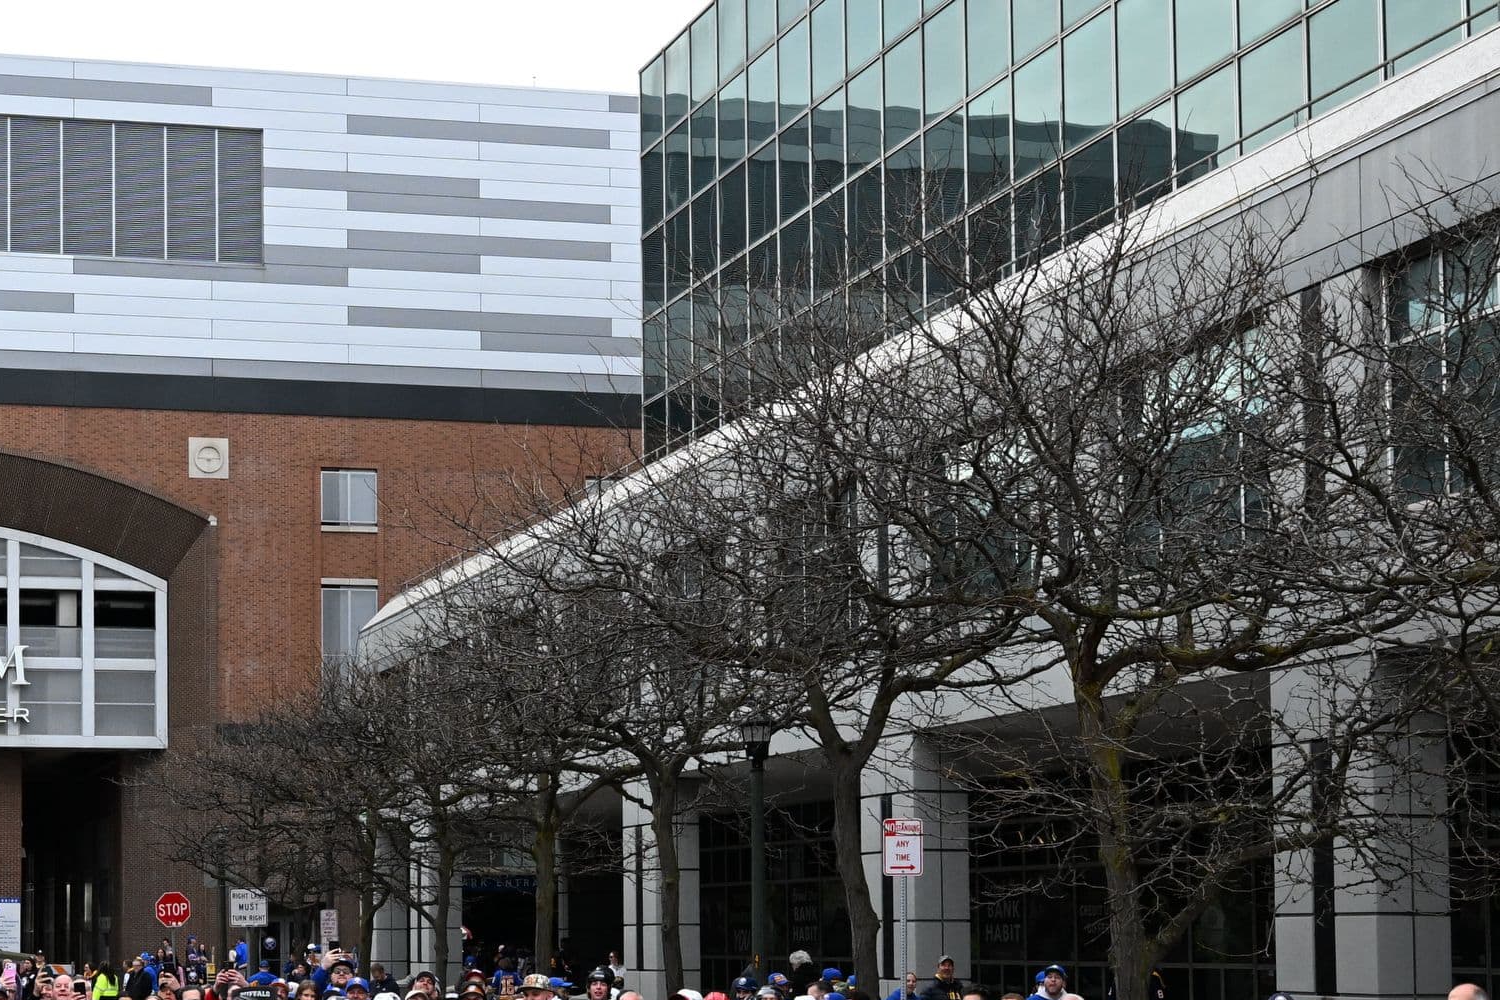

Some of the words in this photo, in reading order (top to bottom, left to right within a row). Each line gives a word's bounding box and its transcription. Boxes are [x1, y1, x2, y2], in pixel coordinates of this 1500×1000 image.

[885, 820, 895, 835] NO
[896, 840, 909, 848] ANY
[896, 853, 910, 861] TIME
[158, 903, 188, 917] STOP
[238, 903, 259, 911] MUST
[984, 923, 1020, 943] HABIT
